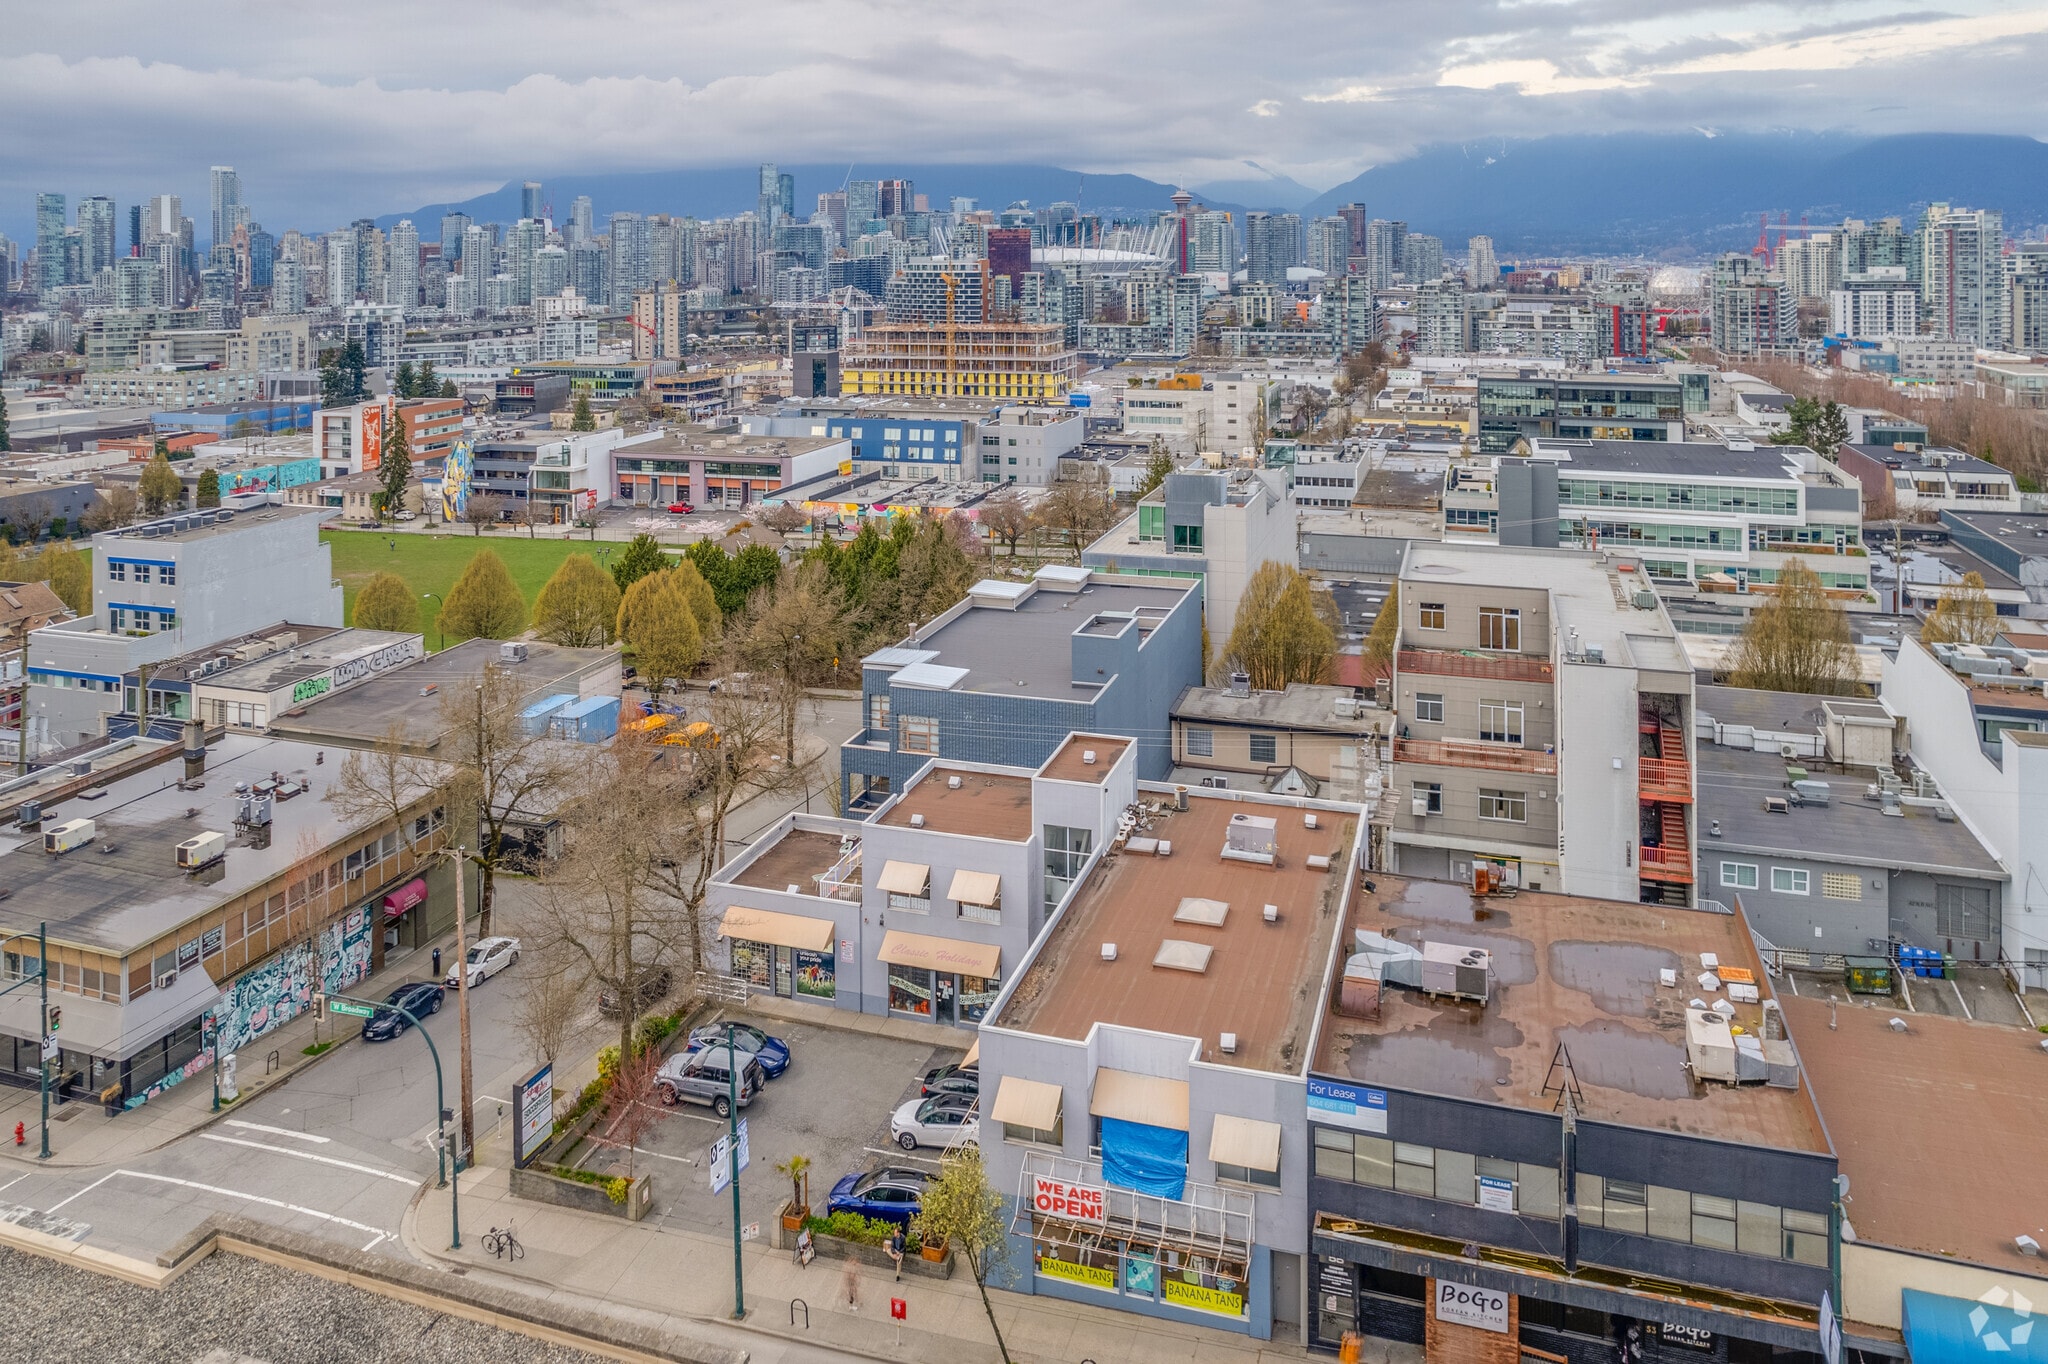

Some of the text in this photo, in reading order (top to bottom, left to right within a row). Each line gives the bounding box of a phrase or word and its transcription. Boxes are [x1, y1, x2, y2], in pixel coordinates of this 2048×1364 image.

[890, 943, 983, 966] Classic Holidays
[342, 1005, 370, 1016] Broadway
[1310, 1083, 1356, 1100] For Lease
[1036, 1180, 1102, 1203] WE ARE
[1494, 1180, 1511, 1188] LEASE
[1036, 1194, 1103, 1221] OPEN!
[1043, 1259, 1084, 1278] BANANA
[1086, 1268, 1112, 1284] TANS
[1168, 1282, 1211, 1303] BANANA
[1213, 1292, 1241, 1309] TANS
[1441, 1307, 1468, 1316] KOREAN
[1472, 1313, 1503, 1322] KITCHEN
[1646, 1325, 1657, 1334] 53
